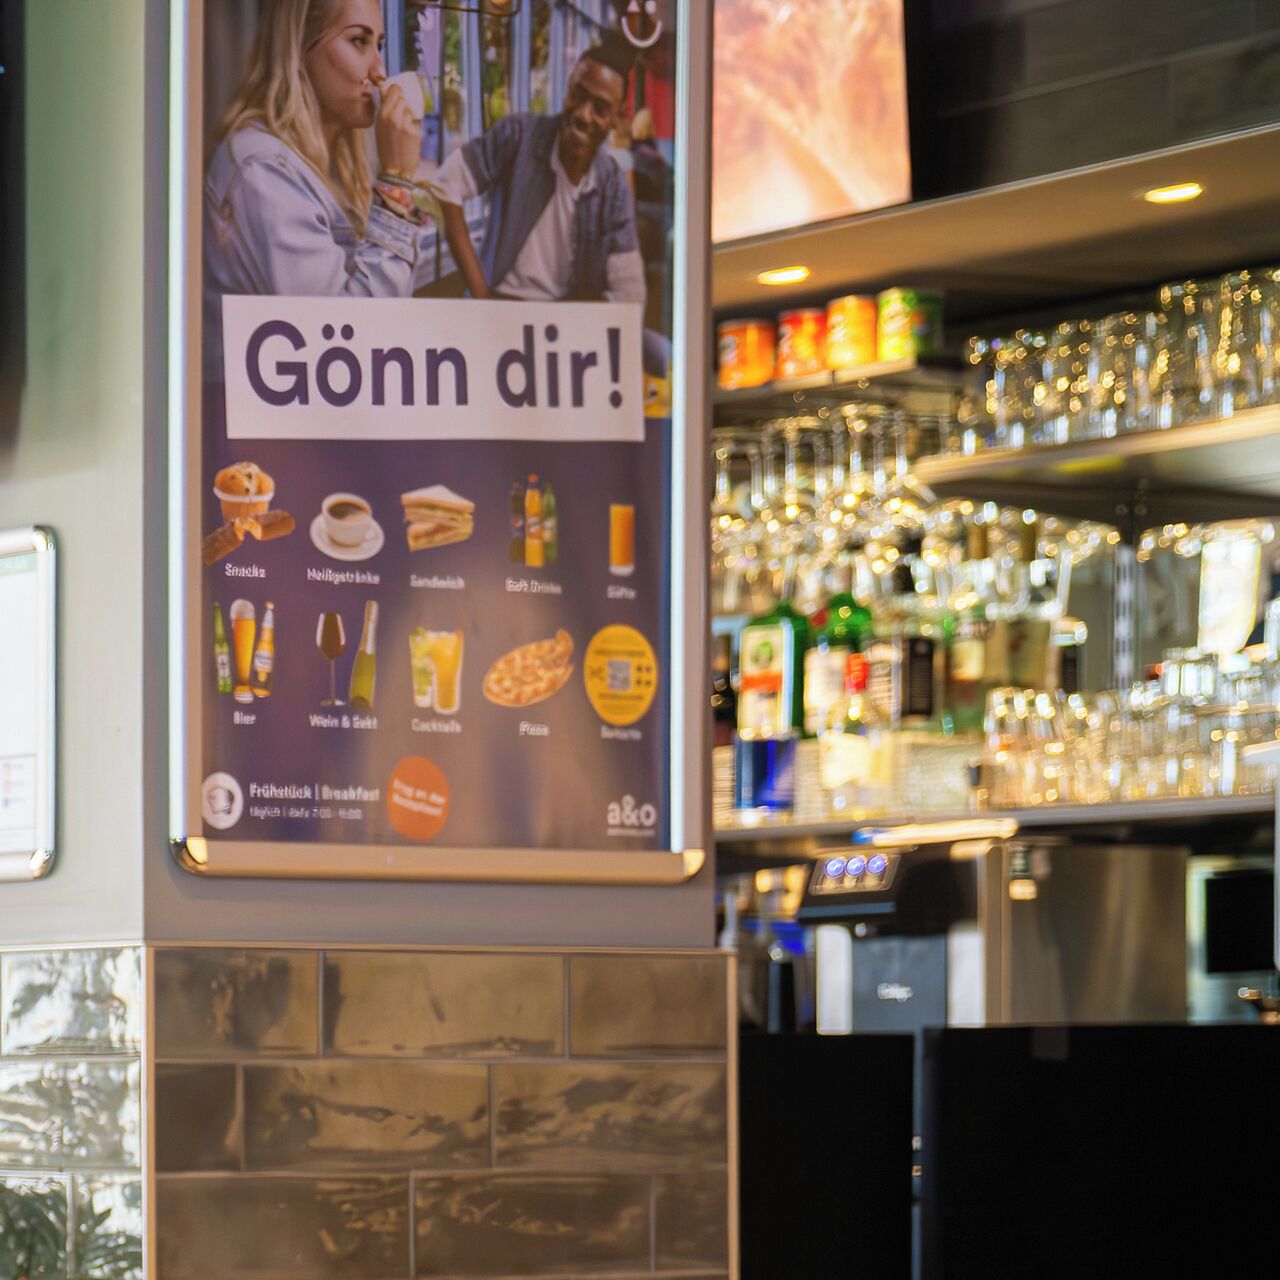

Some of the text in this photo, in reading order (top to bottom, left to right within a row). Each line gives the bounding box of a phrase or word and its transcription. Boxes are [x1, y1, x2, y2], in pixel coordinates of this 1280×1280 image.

[245, 319, 624, 409] Gönn dir!
[224, 563, 266, 578] Snacks
[307, 567, 380, 585] Heißgetränke
[410, 574, 465, 590] Sandwich
[505, 577, 562, 595] Soft Drinks
[233, 711, 256, 725] Bier
[309, 714, 377, 729] Wein & Sekt
[411, 718, 462, 734] Cocktails
[519, 721, 549, 736] Pizza
[249, 782, 312, 799] Frühstück
[322, 784, 380, 801] Breakfast
[607, 794, 657, 827] a&o
